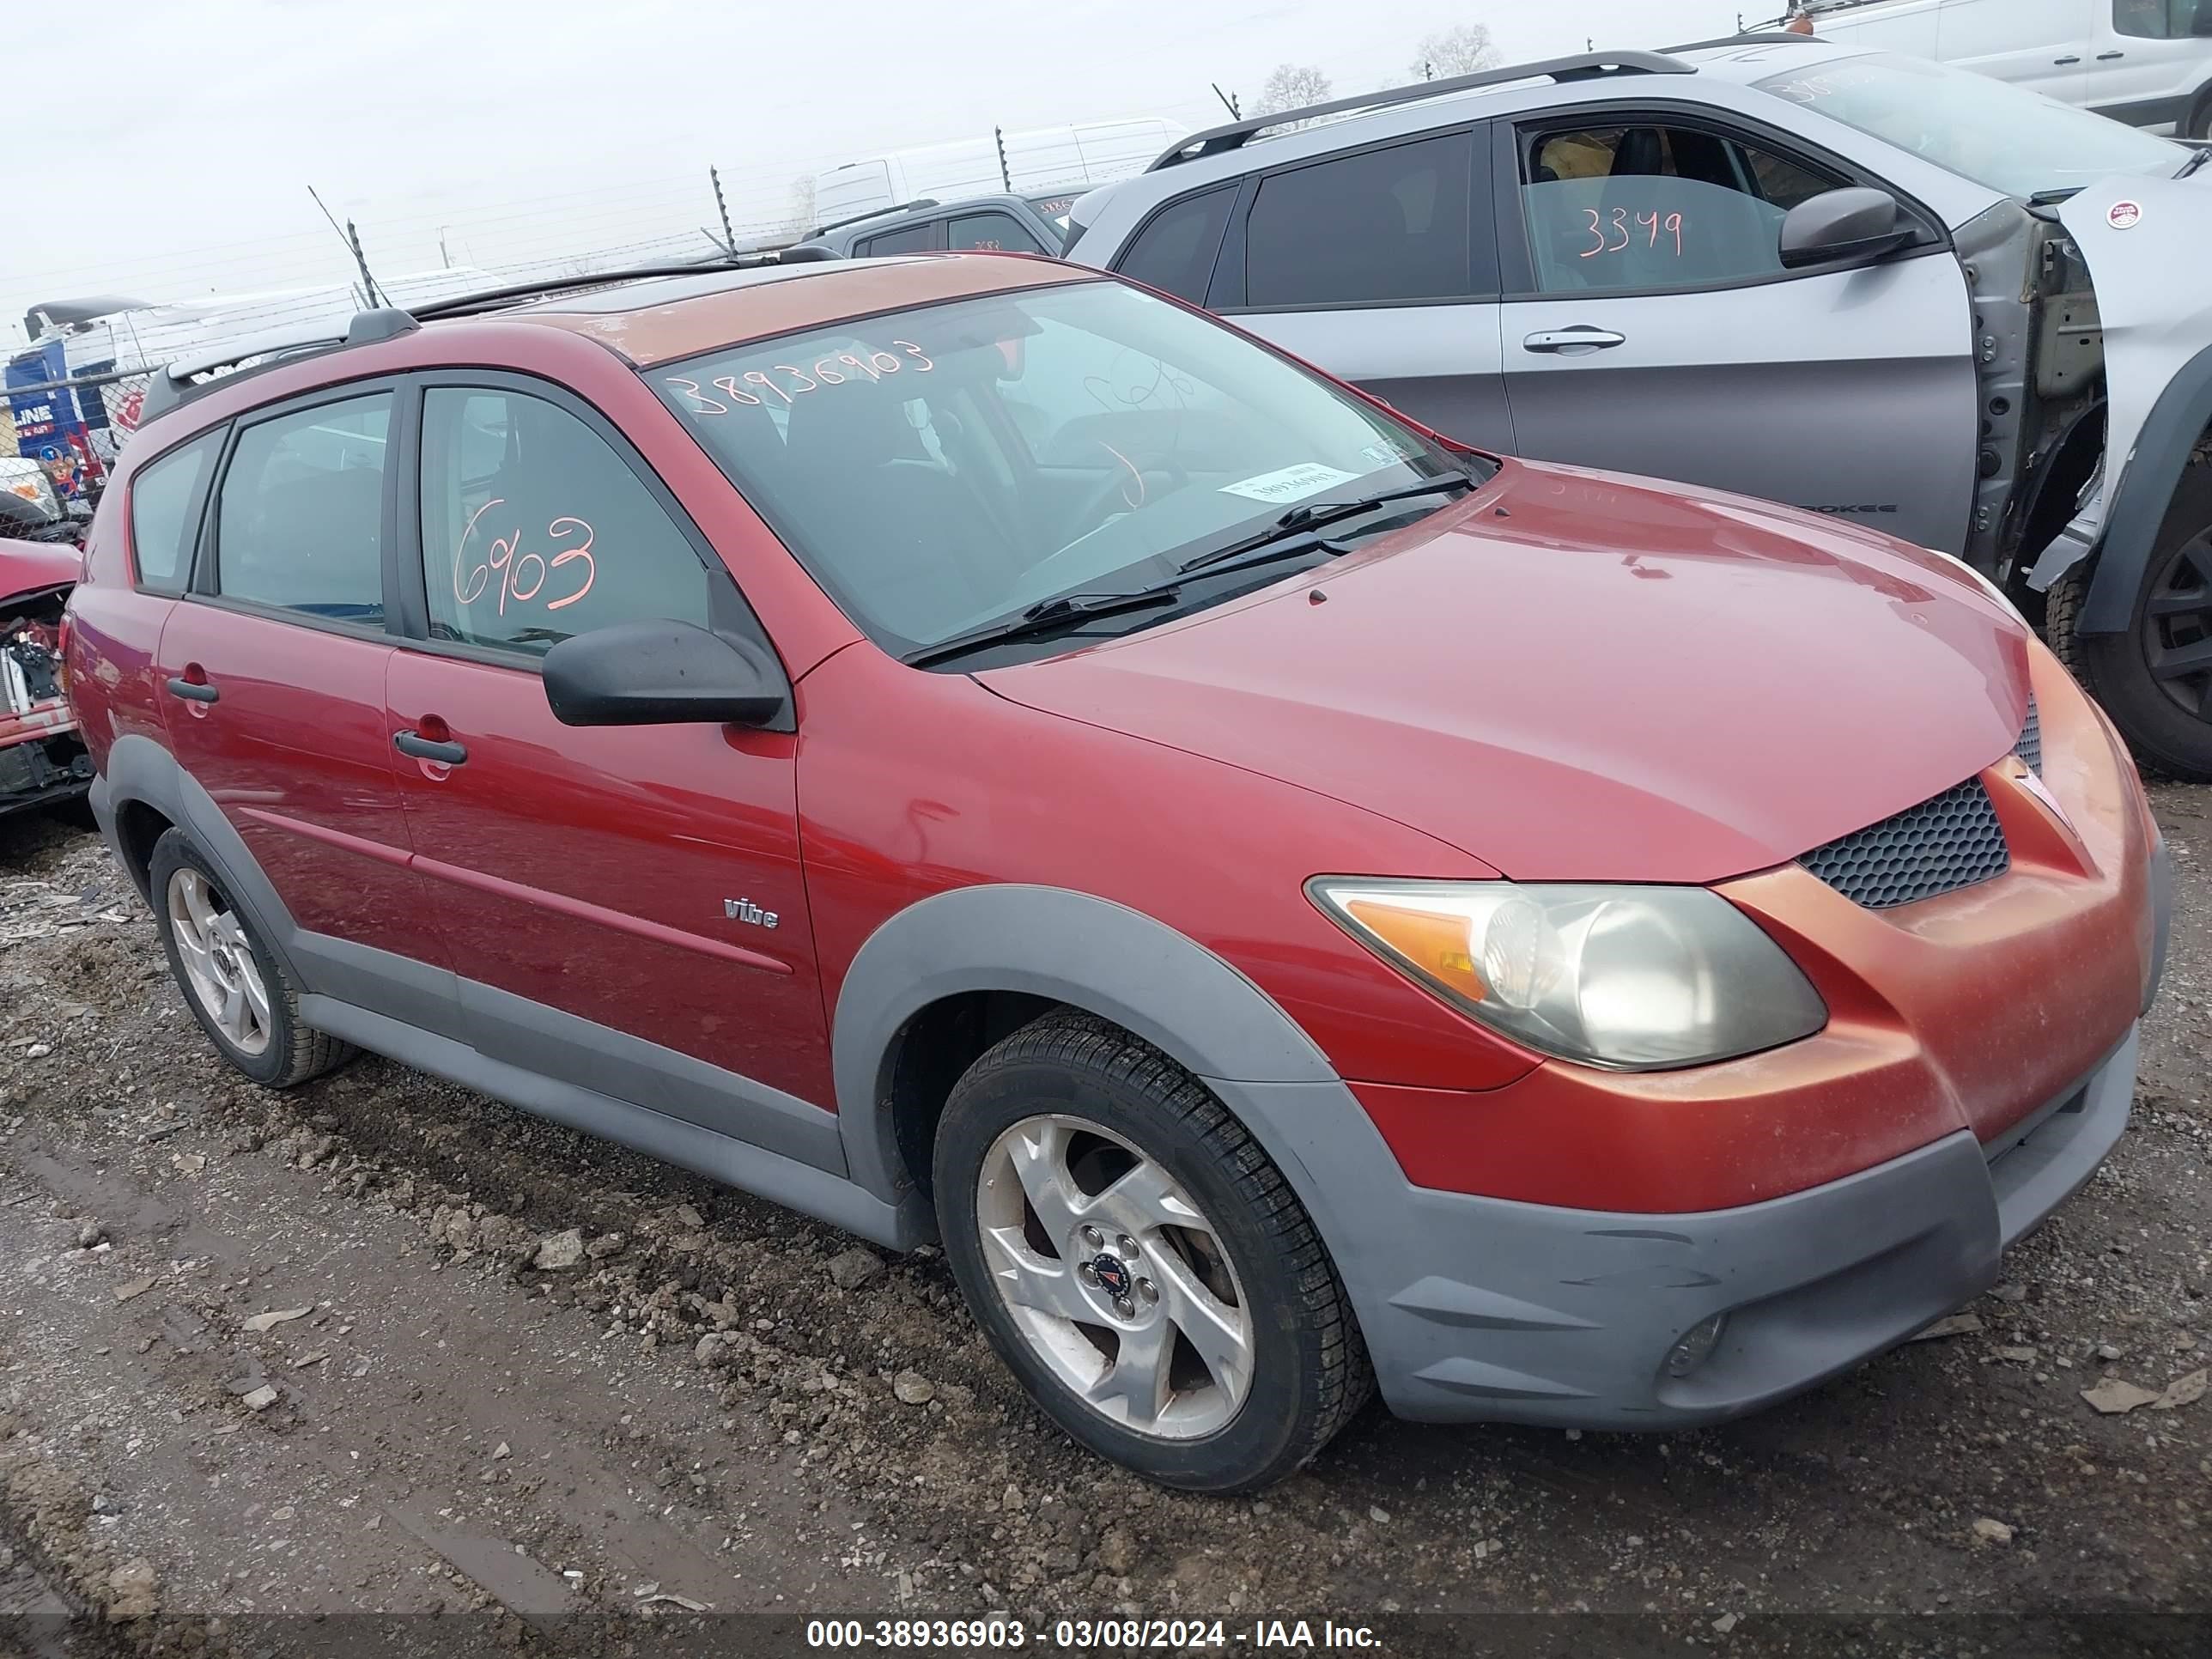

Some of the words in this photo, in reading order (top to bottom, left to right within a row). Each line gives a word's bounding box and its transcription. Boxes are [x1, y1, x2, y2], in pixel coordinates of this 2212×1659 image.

[1579, 207, 1682, 258] 3349
[665, 340, 933, 415] 38936903
[453, 498, 596, 617] 6903
